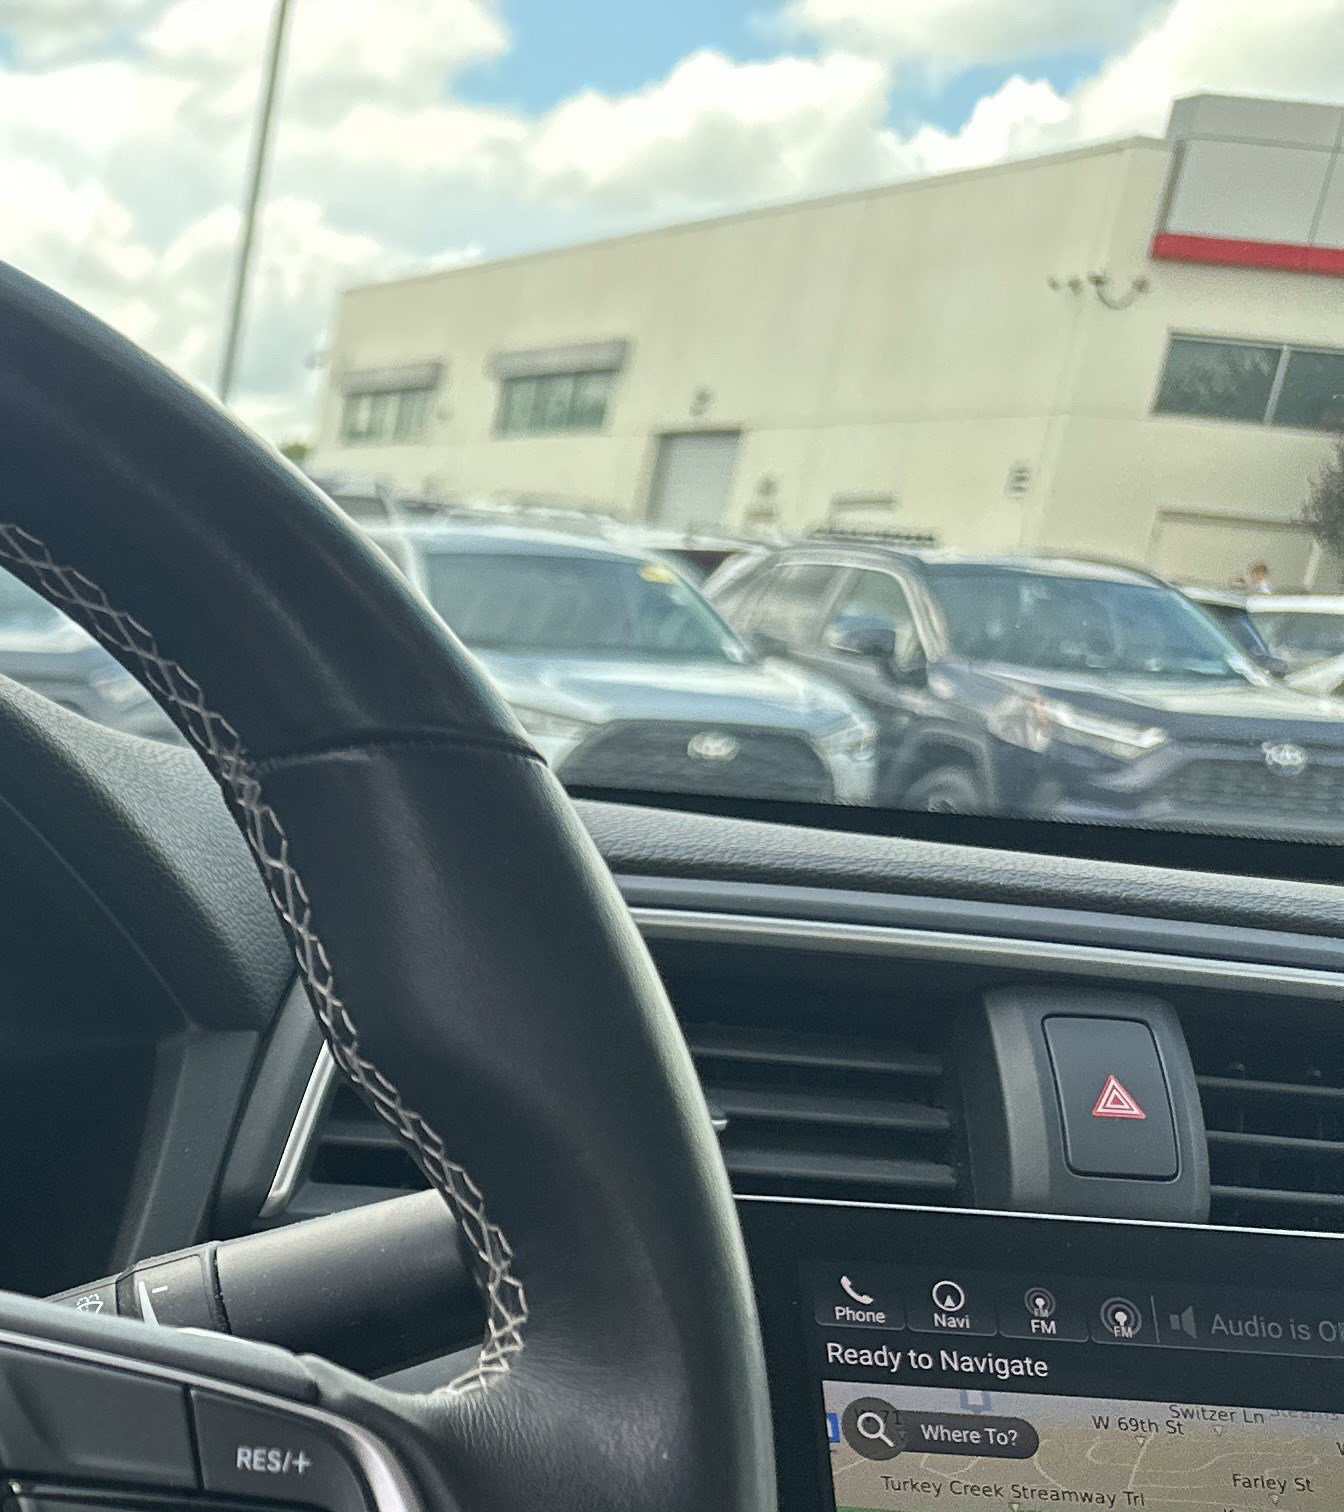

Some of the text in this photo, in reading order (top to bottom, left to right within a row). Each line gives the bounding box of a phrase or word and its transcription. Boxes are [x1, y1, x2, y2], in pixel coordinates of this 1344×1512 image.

[835, 1305, 886, 1324] Phone
[933, 1312, 970, 1329] Navi
[1030, 1319, 1057, 1335] FM
[1113, 1324, 1133, 1338] FM
[1211, 1313, 1283, 1339] Audio
[1289, 1318, 1311, 1341] is
[826, 1342, 1049, 1379] Ready to Navigate
[1169, 1404, 1235, 1421] Switzer
[1243, 1409, 1265, 1424] Ln
[921, 1424, 1018, 1446] Where To?
[1092, 1415, 1185, 1435] W 69th St
[237, 1446, 311, 1475] RES/+
[880, 1476, 1145, 1508] Turkey Creek Streamway Trl
[1232, 1473, 1314, 1494] Farley St
